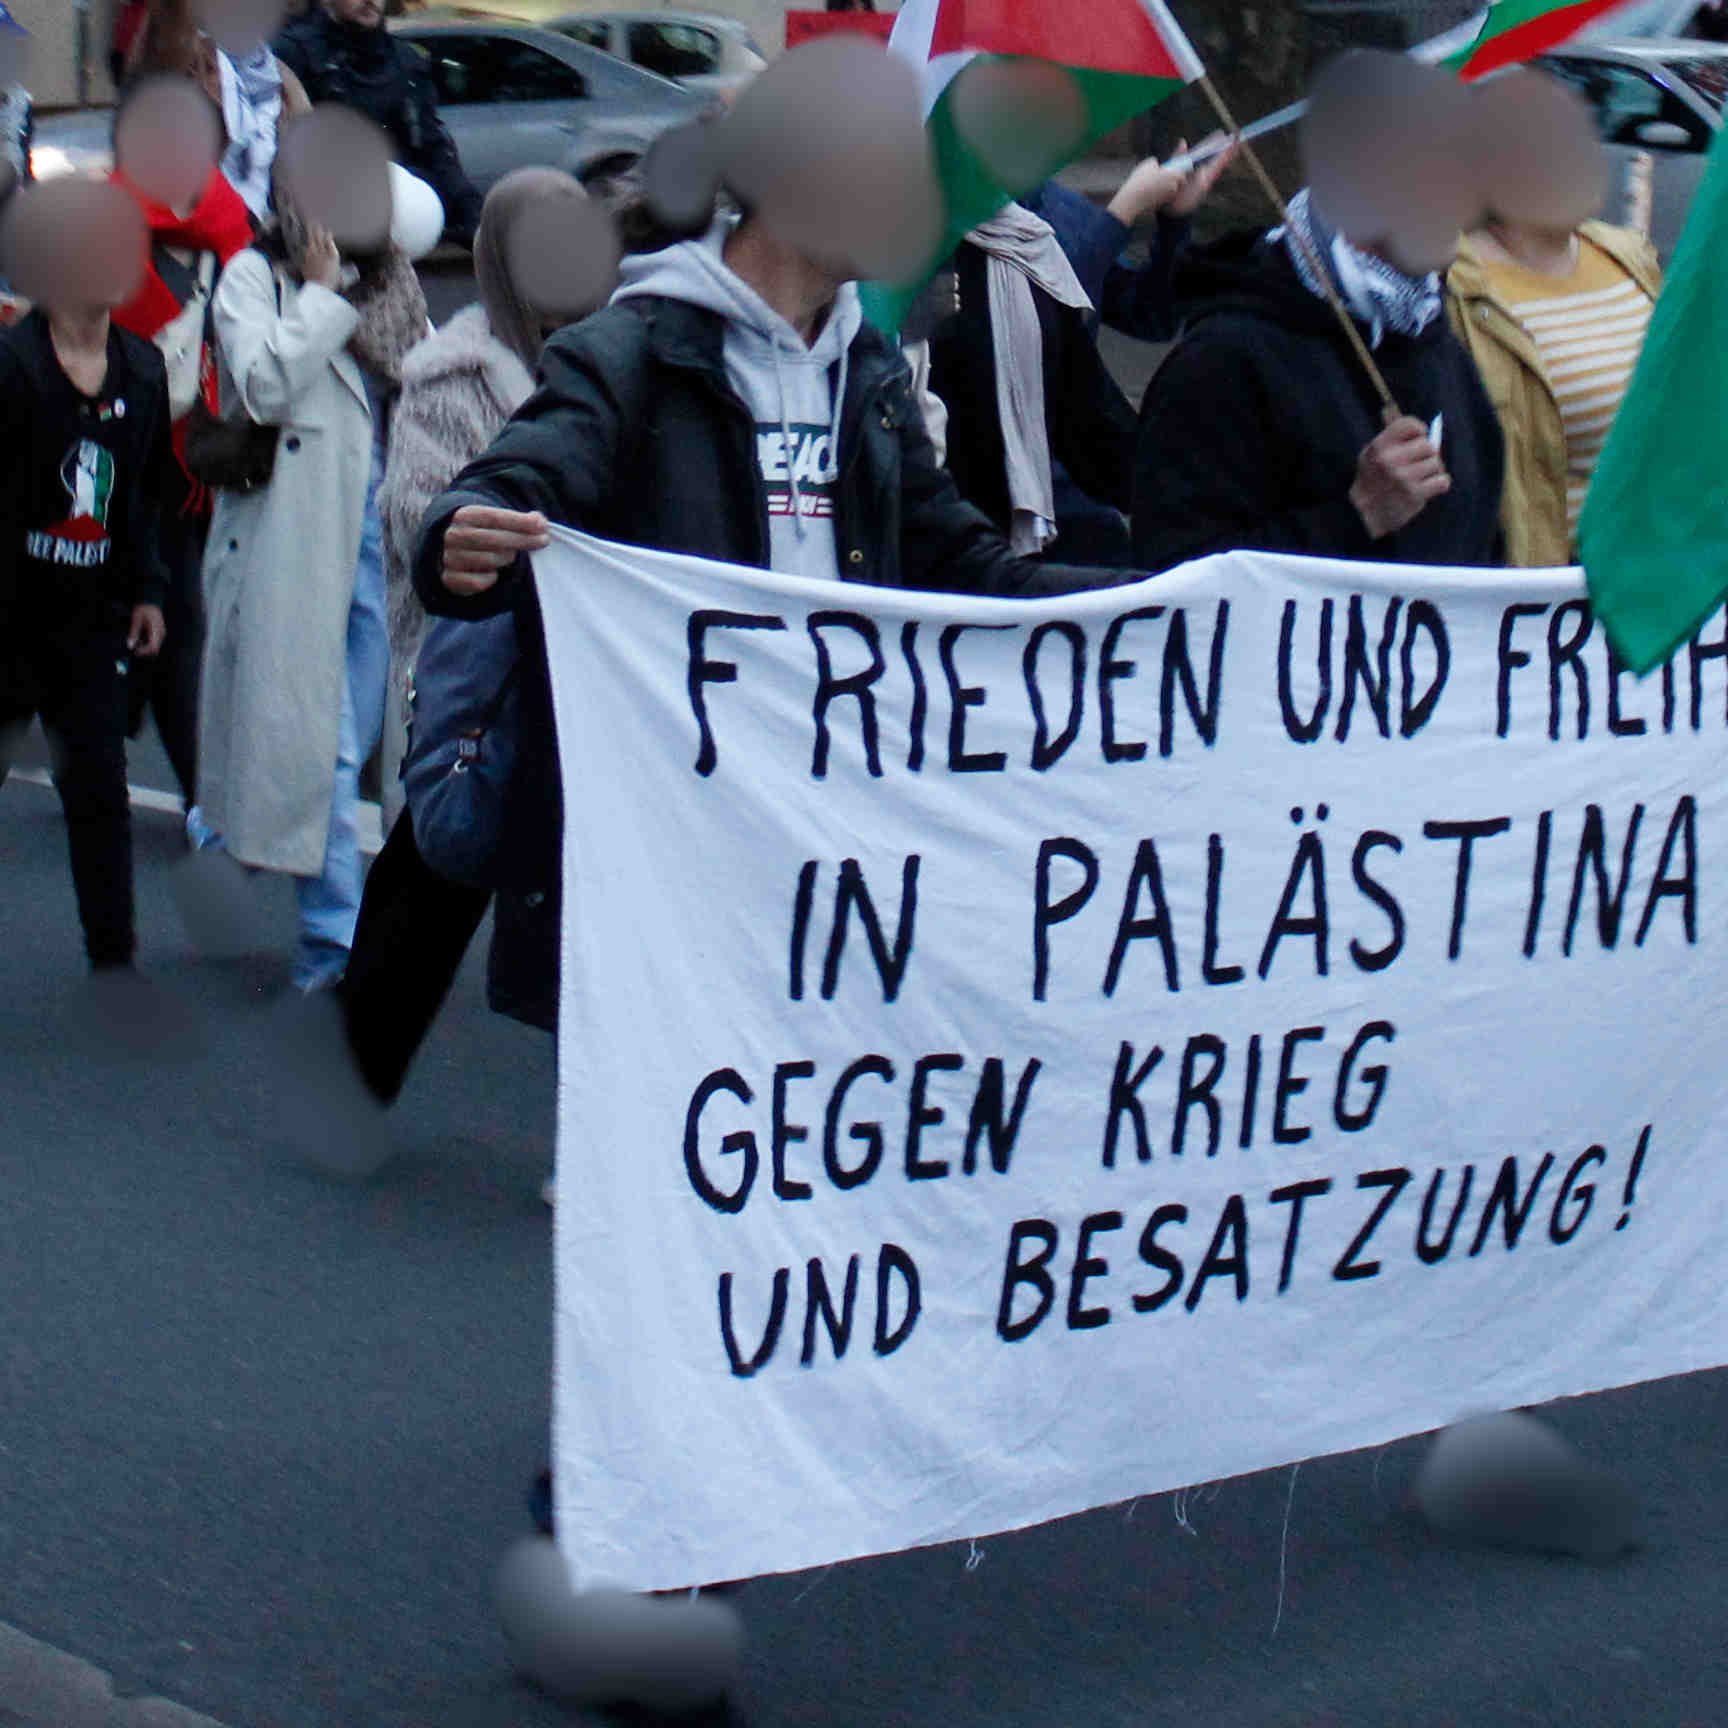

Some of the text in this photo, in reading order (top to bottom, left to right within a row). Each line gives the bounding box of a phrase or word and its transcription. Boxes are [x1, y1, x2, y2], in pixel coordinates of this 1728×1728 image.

[687, 598, 1231, 779] FRIEDEN
[1277, 594, 1452, 744] UND
[790, 854, 921, 1003] IN
[683, 1020, 1395, 1214] GEGEN KRIEG
[718, 1124, 1652, 1378] UND BESATZUNG!
